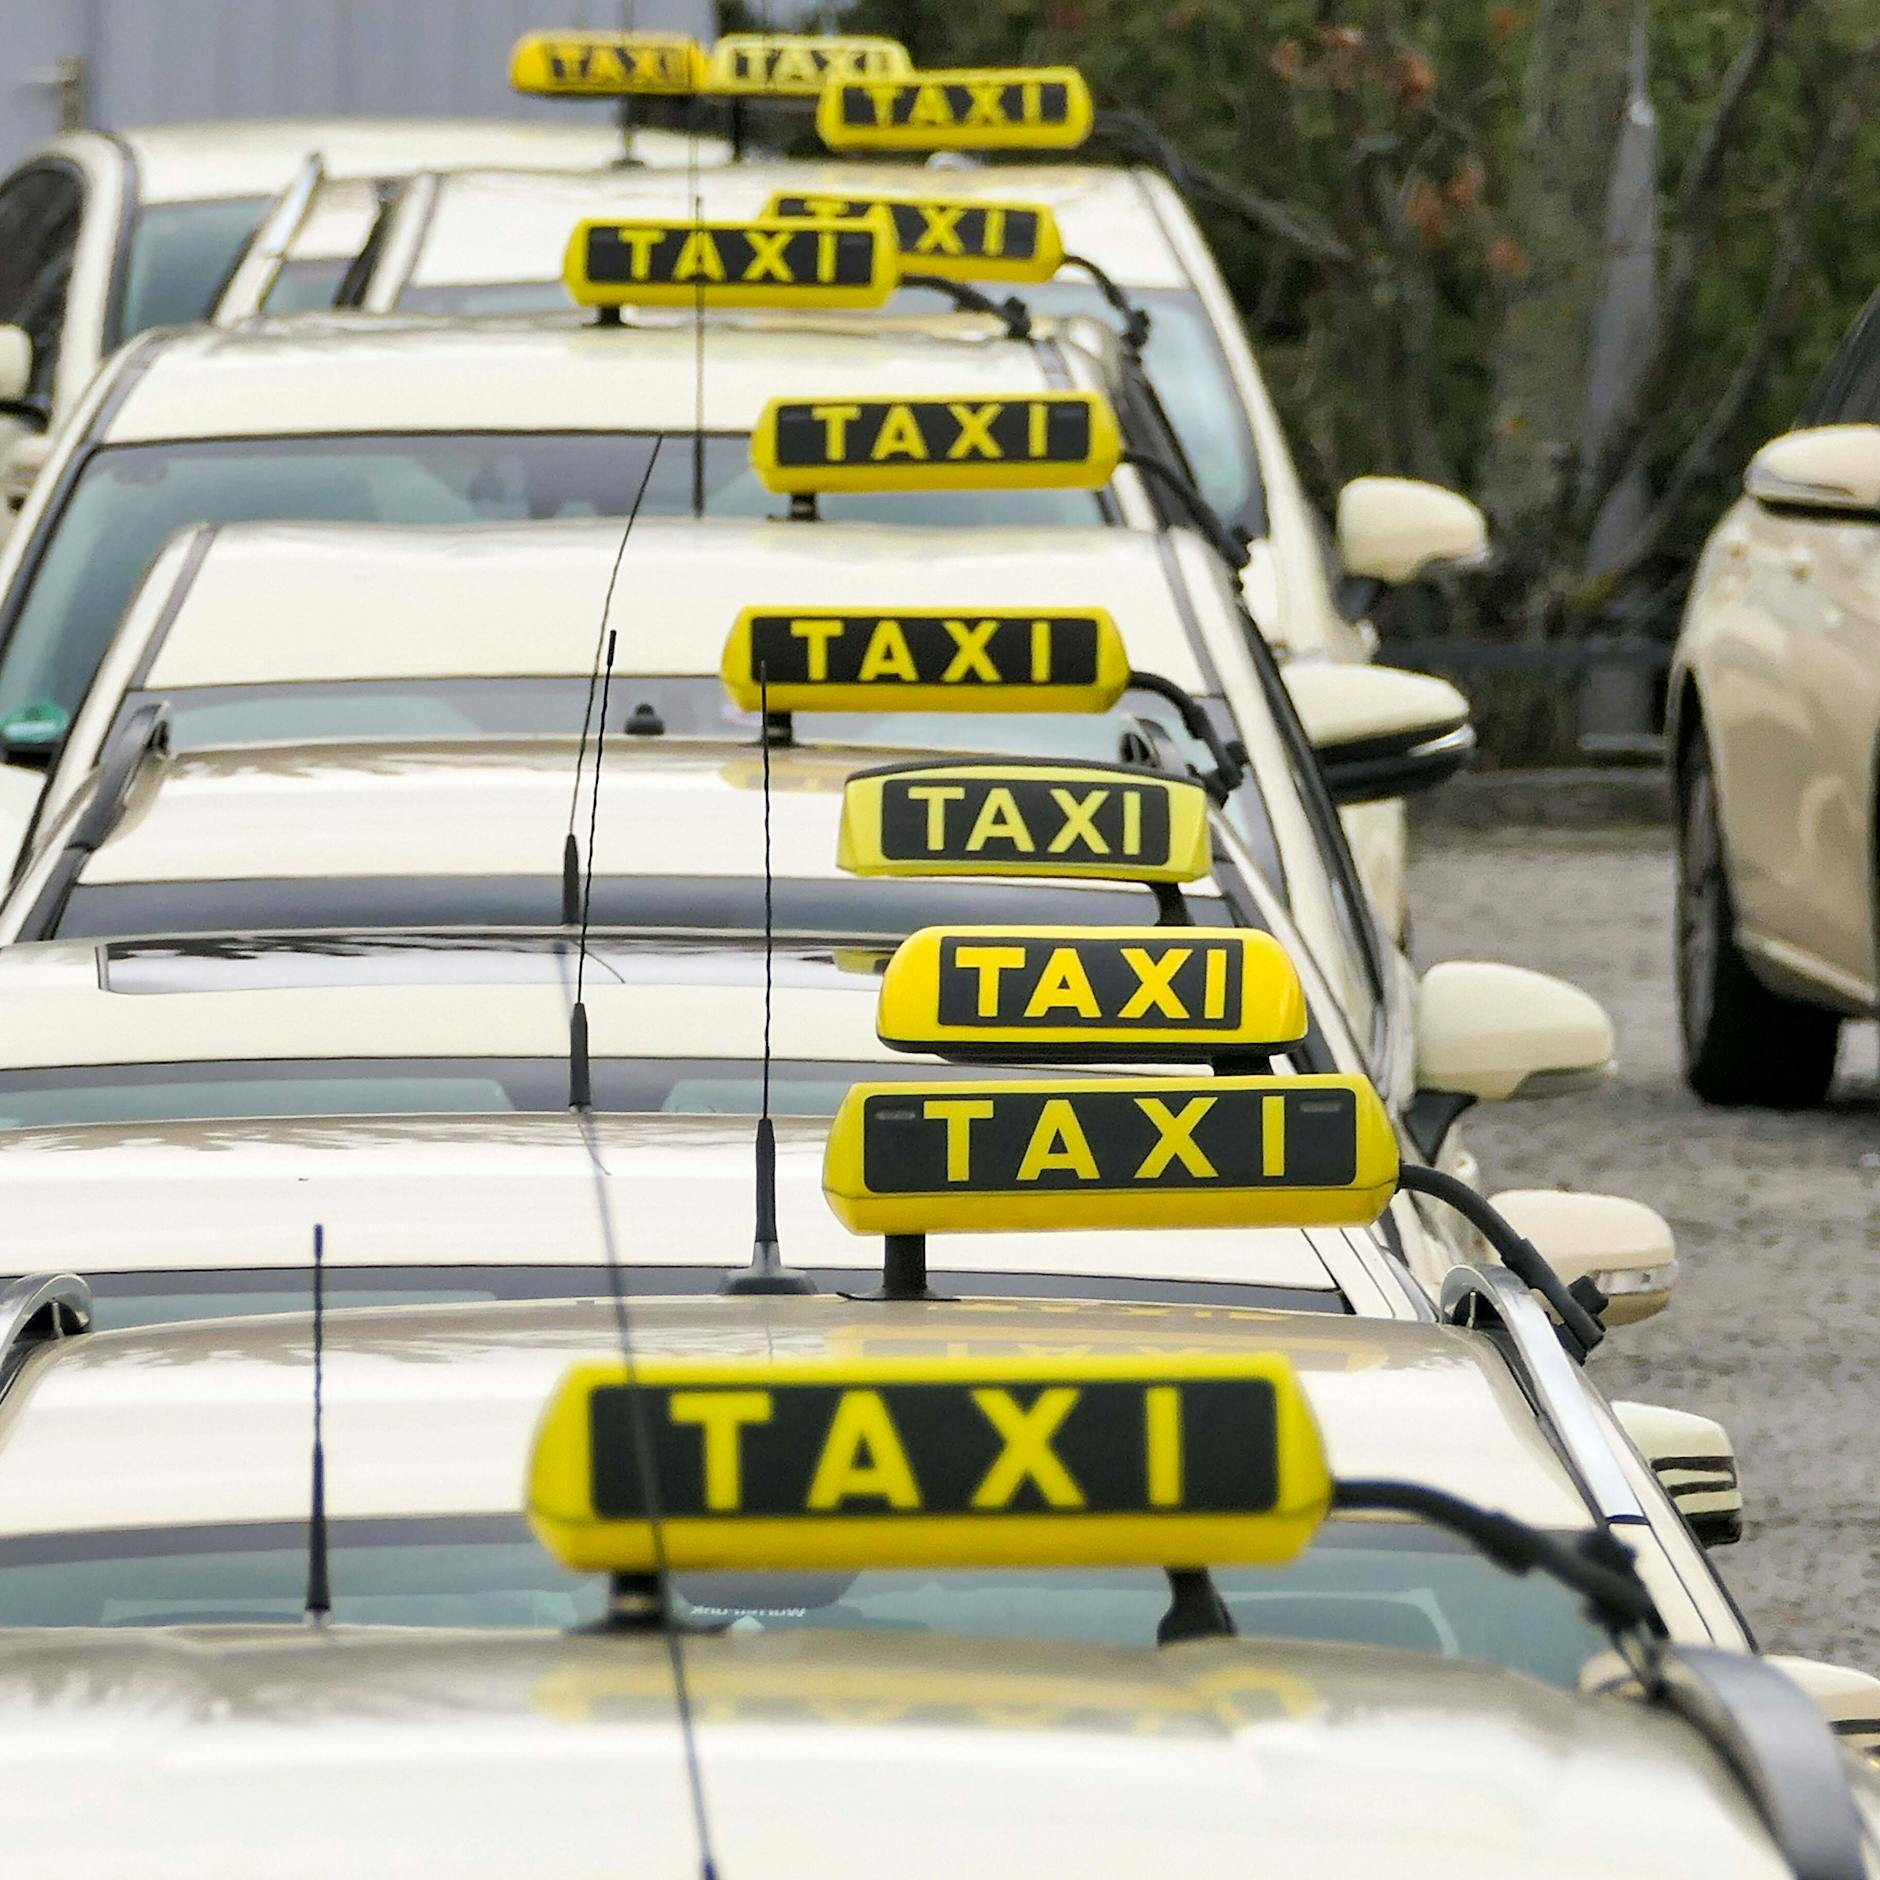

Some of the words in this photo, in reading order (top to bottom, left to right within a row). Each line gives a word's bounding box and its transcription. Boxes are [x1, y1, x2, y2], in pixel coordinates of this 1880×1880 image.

[548, 47, 681, 81] TAXI
[735, 48, 883, 82] TAXI
[864, 85, 1042, 124] TAXI
[619, 230, 836, 281] TAXI
[812, 403, 1049, 460] TAXI
[791, 620, 1052, 682] TAXI
[908, 787, 1142, 855] TAXI
[955, 947, 1228, 1020] TAXI
[923, 1096, 1285, 1182] TAXI
[670, 1387, 1183, 1511] TAXI
